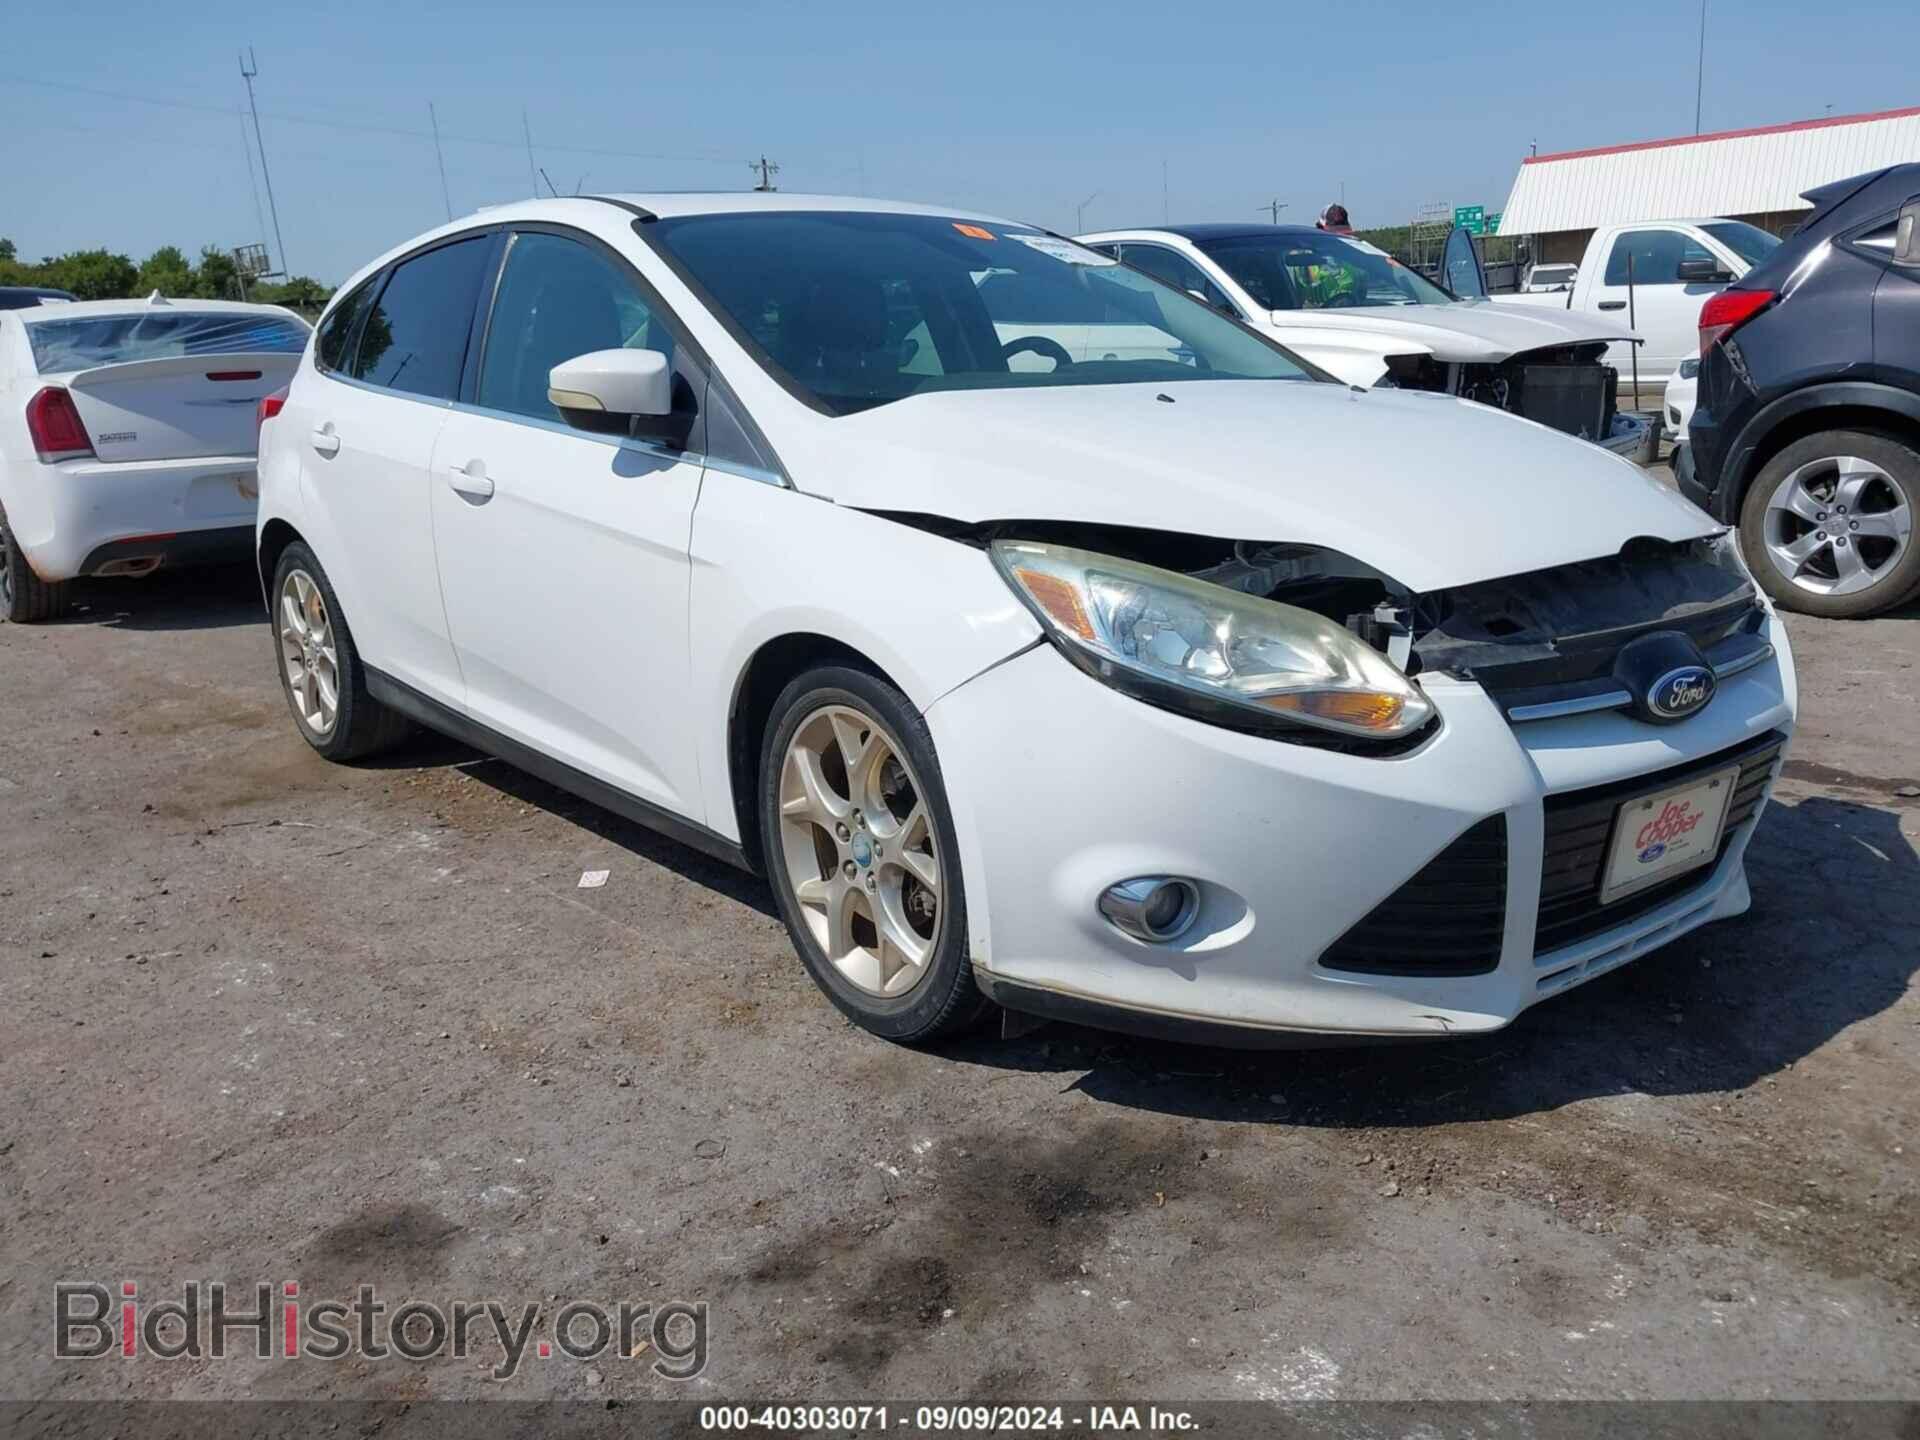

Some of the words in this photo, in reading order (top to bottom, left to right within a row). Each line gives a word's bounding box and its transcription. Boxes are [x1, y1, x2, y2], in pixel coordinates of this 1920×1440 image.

[1669, 676, 1705, 708] Ford
[1659, 800, 1691, 824] Joe
[1635, 811, 1704, 849] Cooper
